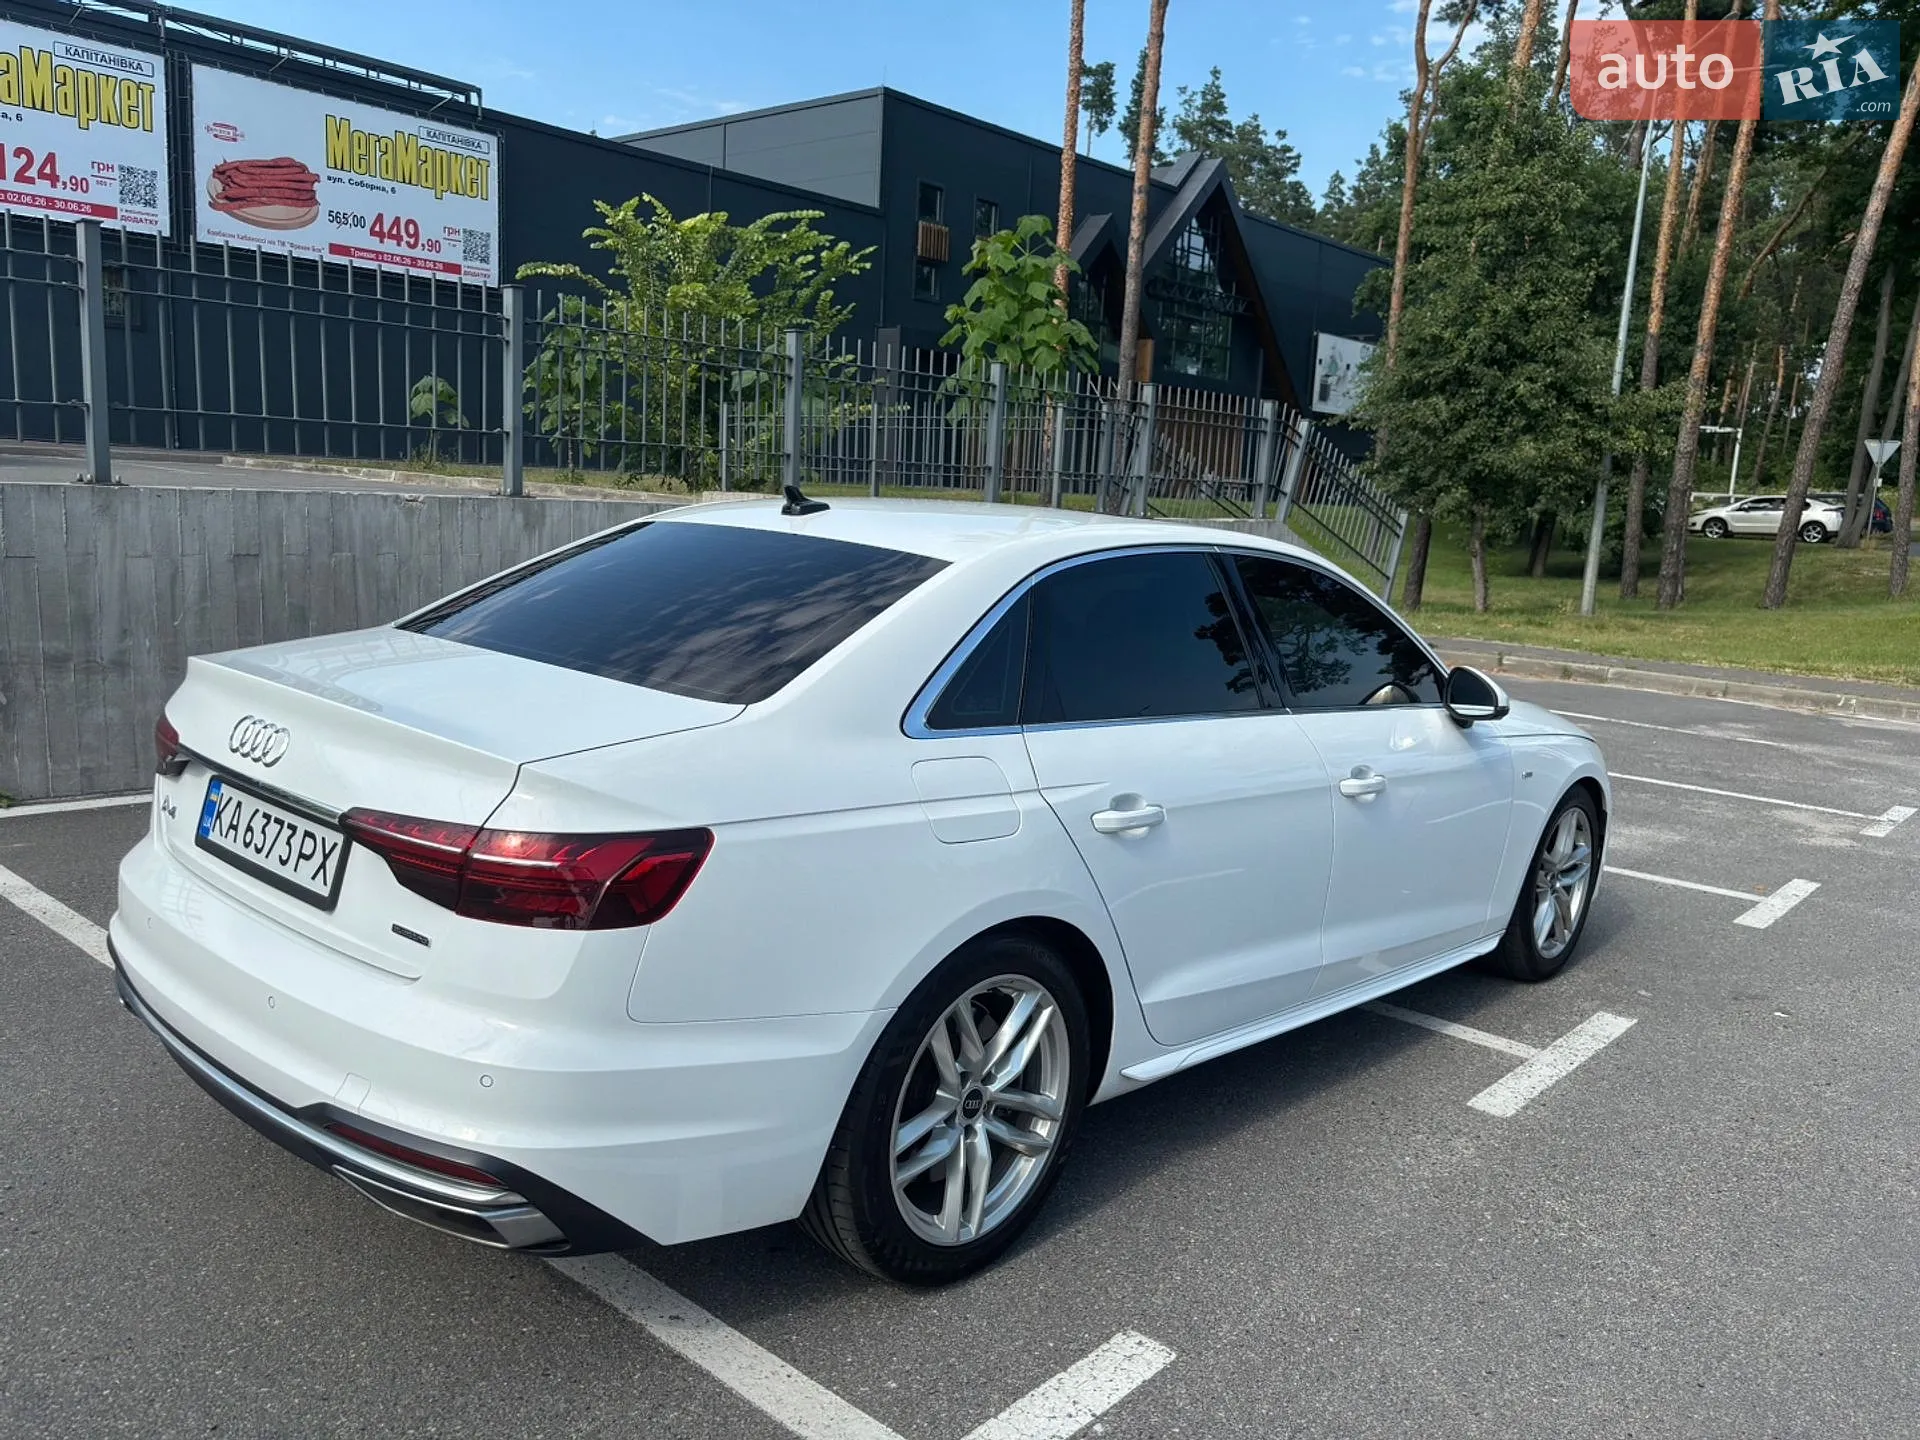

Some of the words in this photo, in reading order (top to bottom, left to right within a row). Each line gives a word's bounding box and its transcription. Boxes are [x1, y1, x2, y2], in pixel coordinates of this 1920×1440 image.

[65, 45, 144, 72] КАПІТАНІВКА
[15, 113, 23, 122] 6
[426, 129, 483, 150] КАПІТАНІВКА
[91, 161, 115, 174] грн
[325, 114, 490, 201] МегаМаркет
[7, 192, 47, 206] 02.06.26
[54, 201, 92, 214] 30.06.26
[369, 212, 442, 254] 449,90
[443, 226, 460, 237] грн
